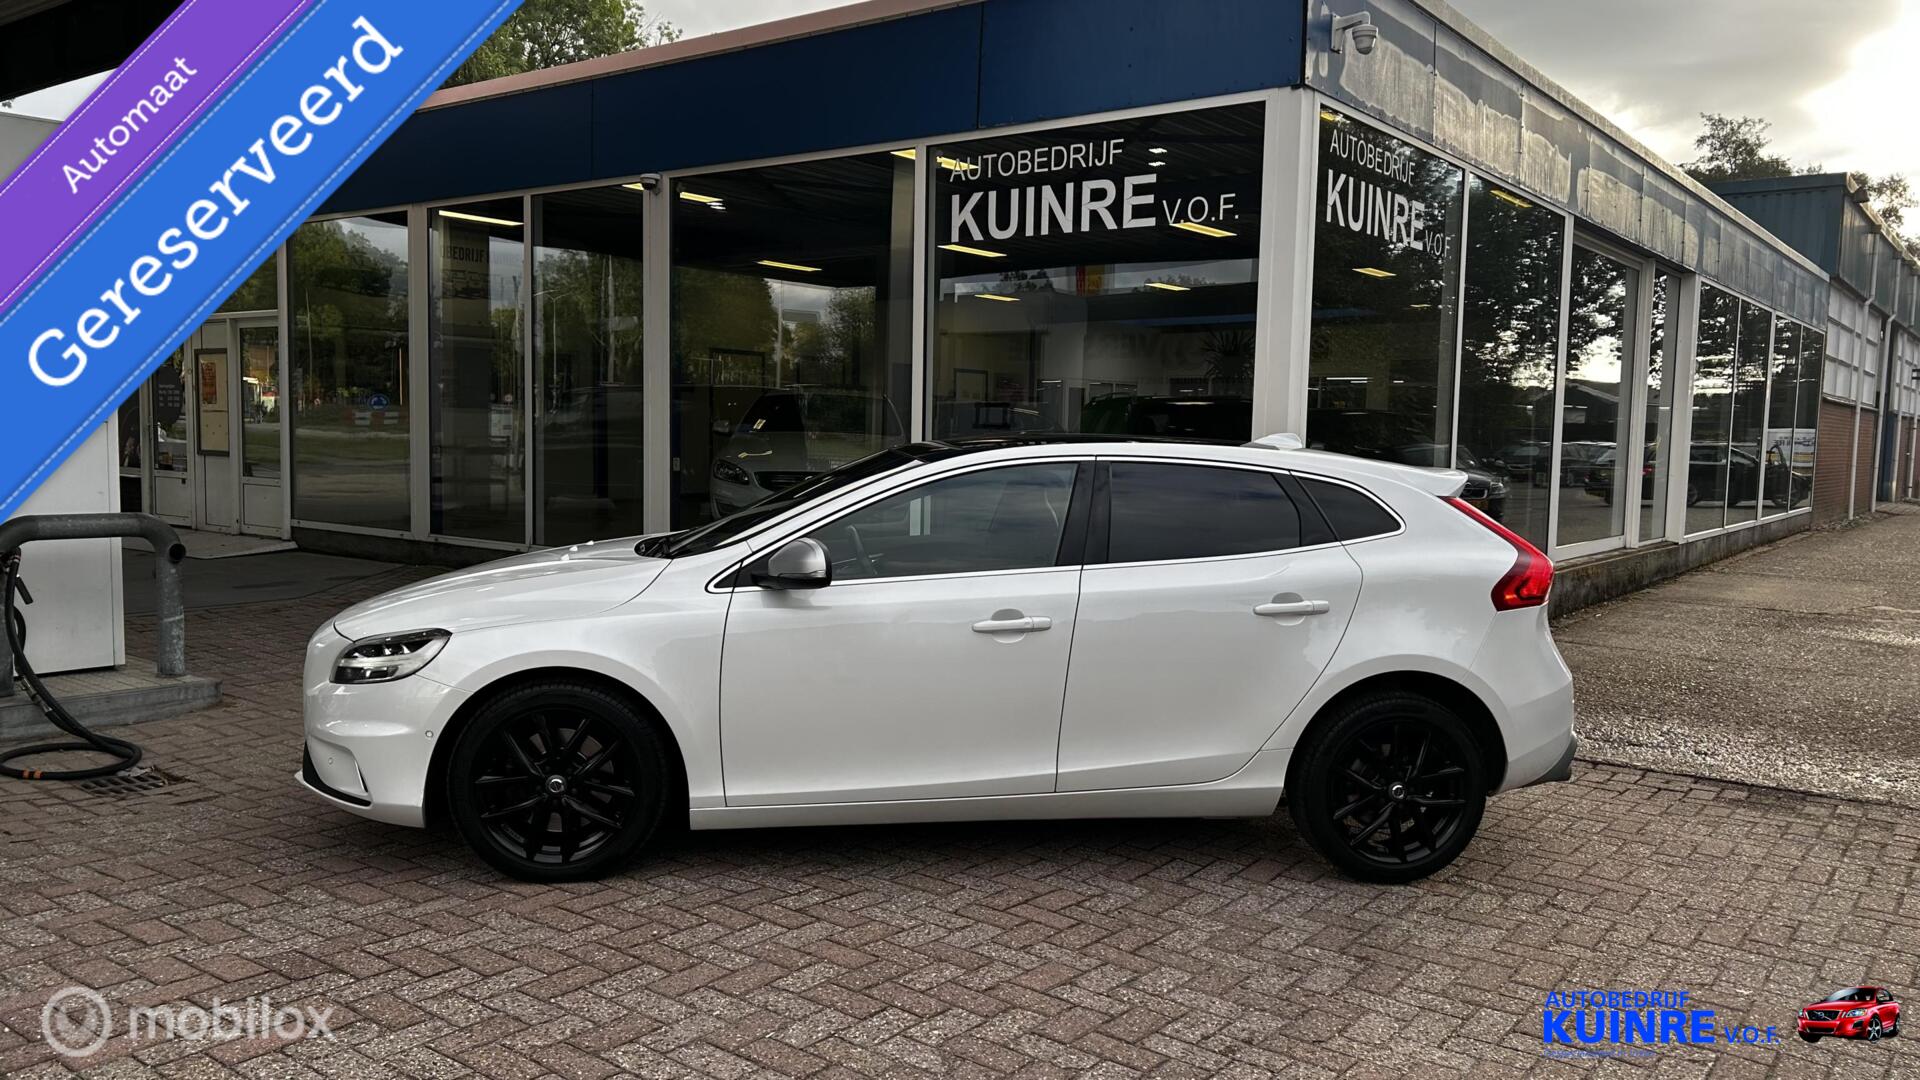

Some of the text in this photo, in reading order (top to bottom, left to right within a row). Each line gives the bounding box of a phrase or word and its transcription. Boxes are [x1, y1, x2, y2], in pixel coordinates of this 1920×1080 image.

[950, 138, 1125, 182] AUTOBEDRIJF
[1330, 128, 1416, 187] AUTOBEDRIJF
[951, 173, 1240, 243] KUINRE V.O.F.
[1326, 168, 1425, 251] KUINRE
